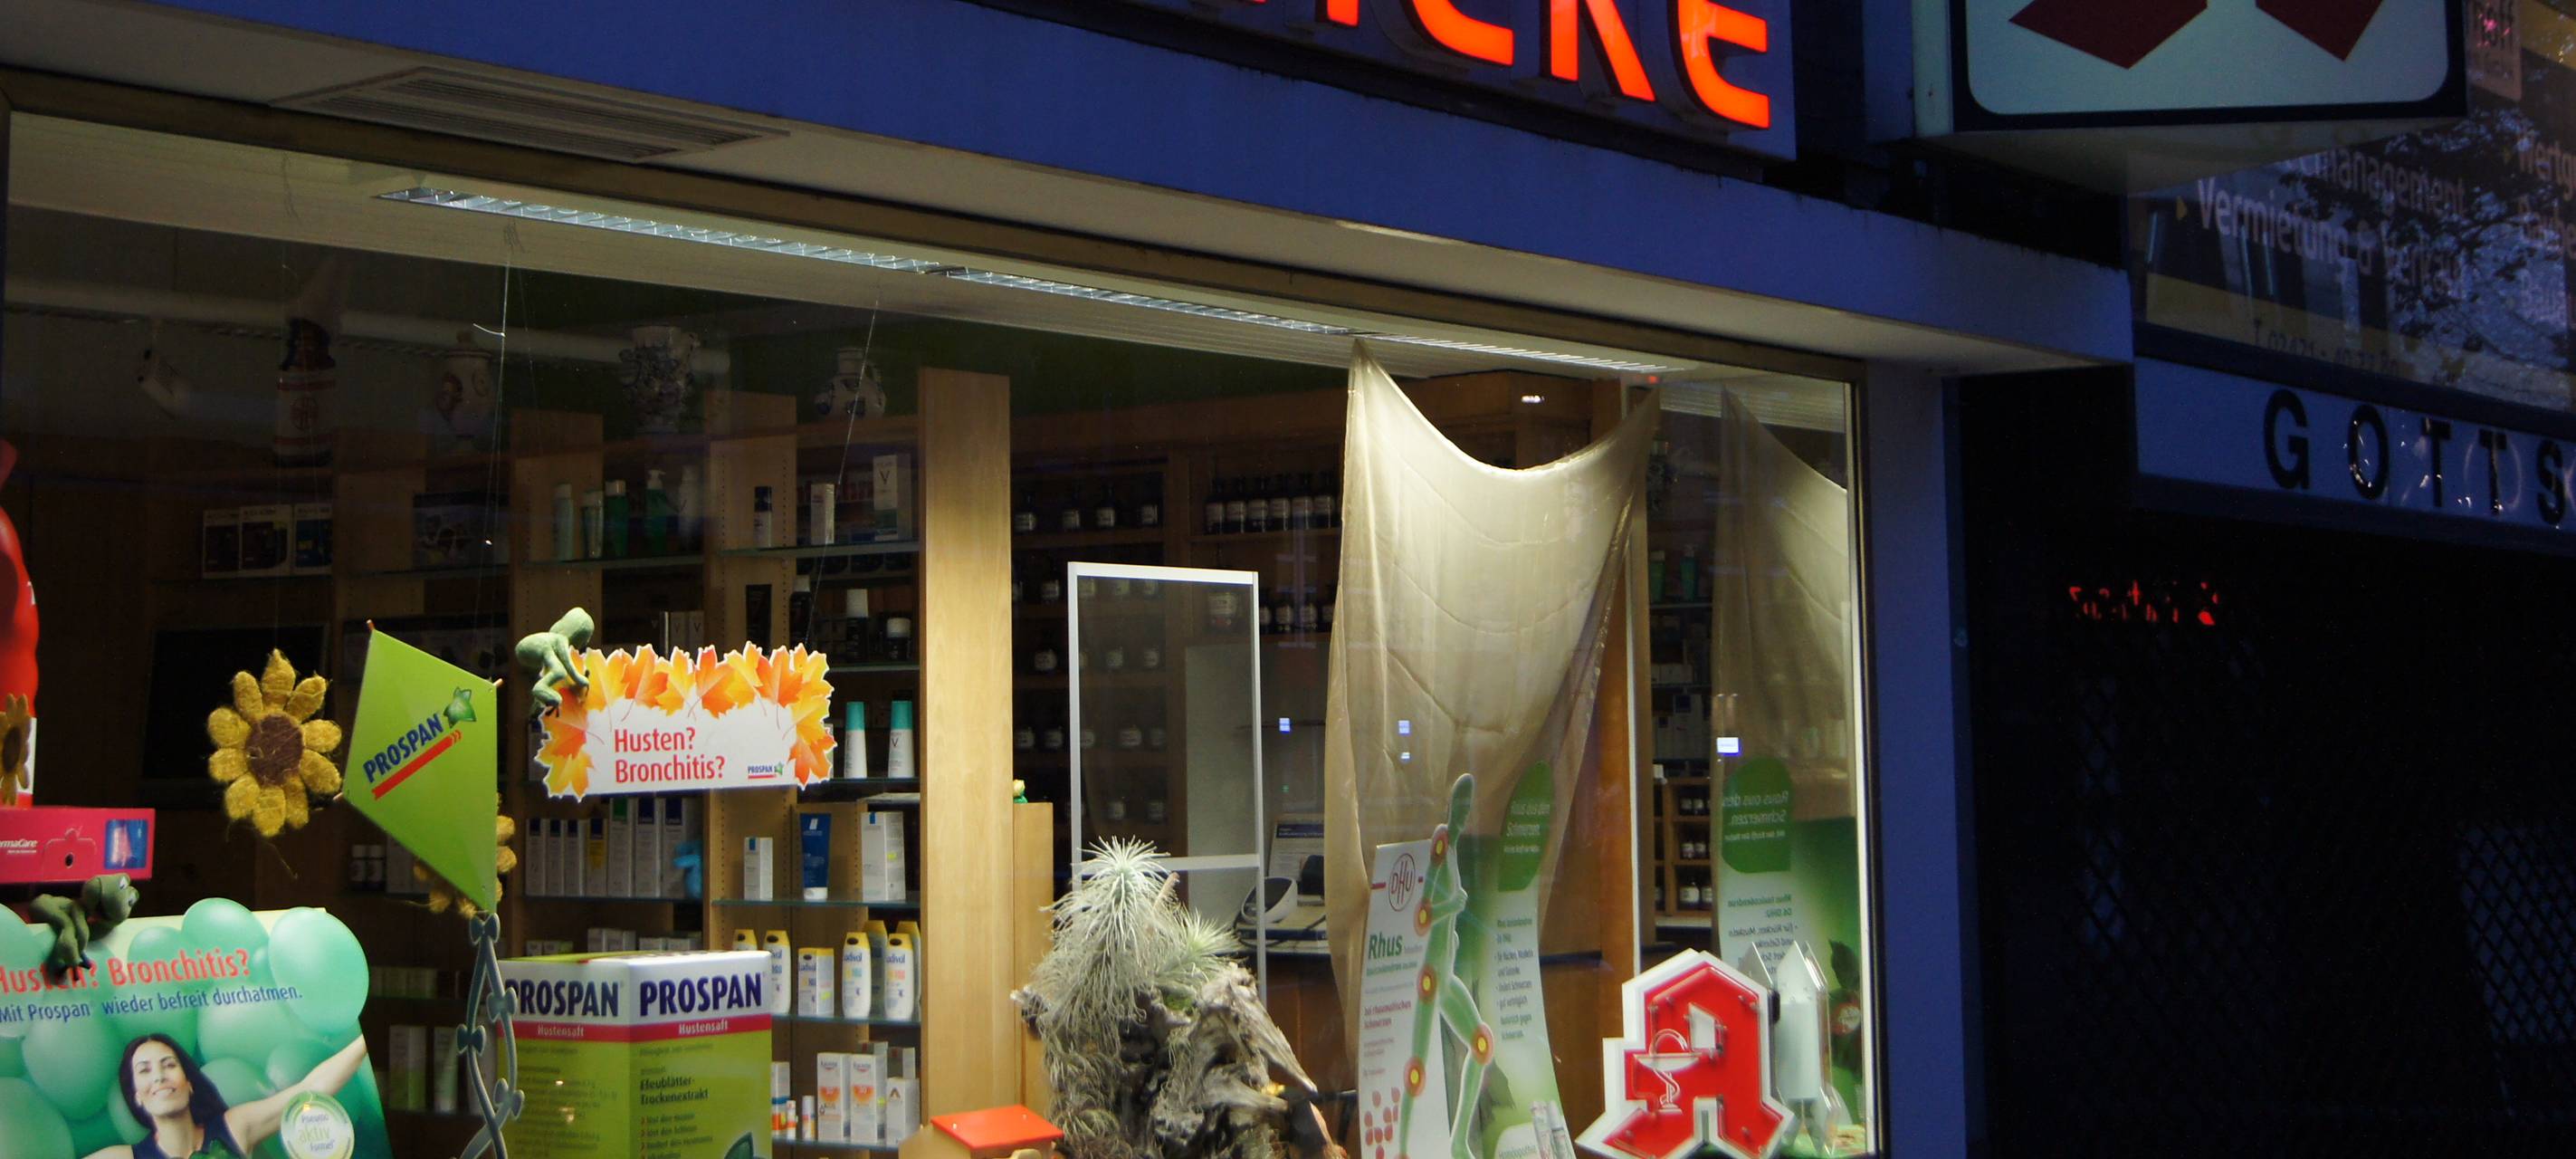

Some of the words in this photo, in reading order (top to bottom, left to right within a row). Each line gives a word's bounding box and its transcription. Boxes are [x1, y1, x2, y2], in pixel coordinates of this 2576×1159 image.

[2264, 388, 2566, 525] GOTTS
[363, 713, 444, 783] PROSPAN
[615, 727, 696, 752] Husten?
[615, 754, 725, 783] Bronchitis?
[747, 765, 773, 774] PROSPAN
[1368, 932, 1403, 960] Rhus
[107, 948, 251, 986] Bronchitis?
[0, 1003, 24, 1023] Mit
[27, 1002, 91, 1023] Prospan
[101, 994, 154, 1015] wieder
[157, 991, 209, 1011] befreit
[213, 985, 303, 1005] durchatmen.
[639, 972, 762, 1016] PROSPAN
[678, 1019, 730, 1036] Hustensaft
